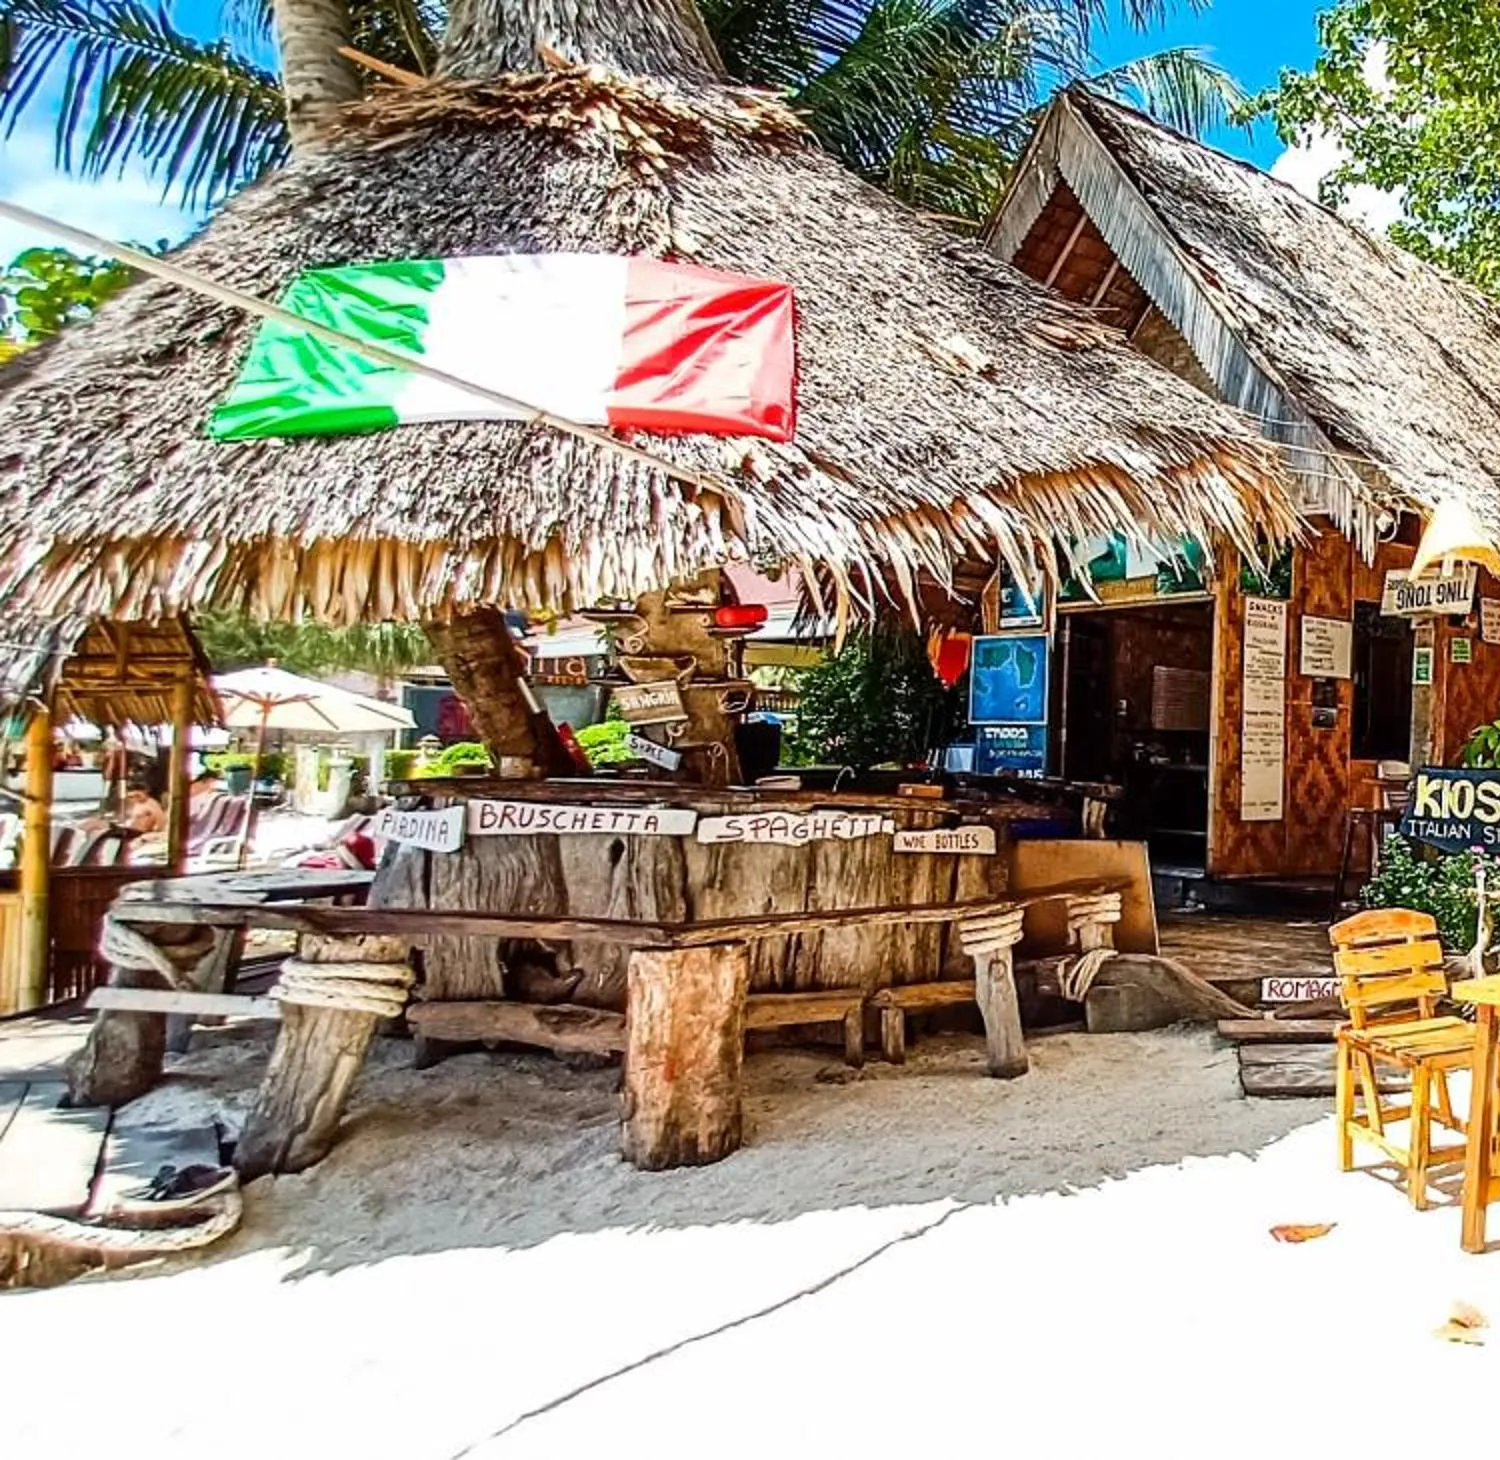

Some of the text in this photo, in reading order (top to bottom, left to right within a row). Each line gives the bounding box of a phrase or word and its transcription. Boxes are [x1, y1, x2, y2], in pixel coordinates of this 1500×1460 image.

[1396, 585, 1432, 610] TONG
[1436, 581, 1469, 604] TING
[479, 803, 659, 832] BRUSCHETTA
[1408, 819, 1471, 839] ITALIAN
[934, 832, 979, 850] BOTTLES
